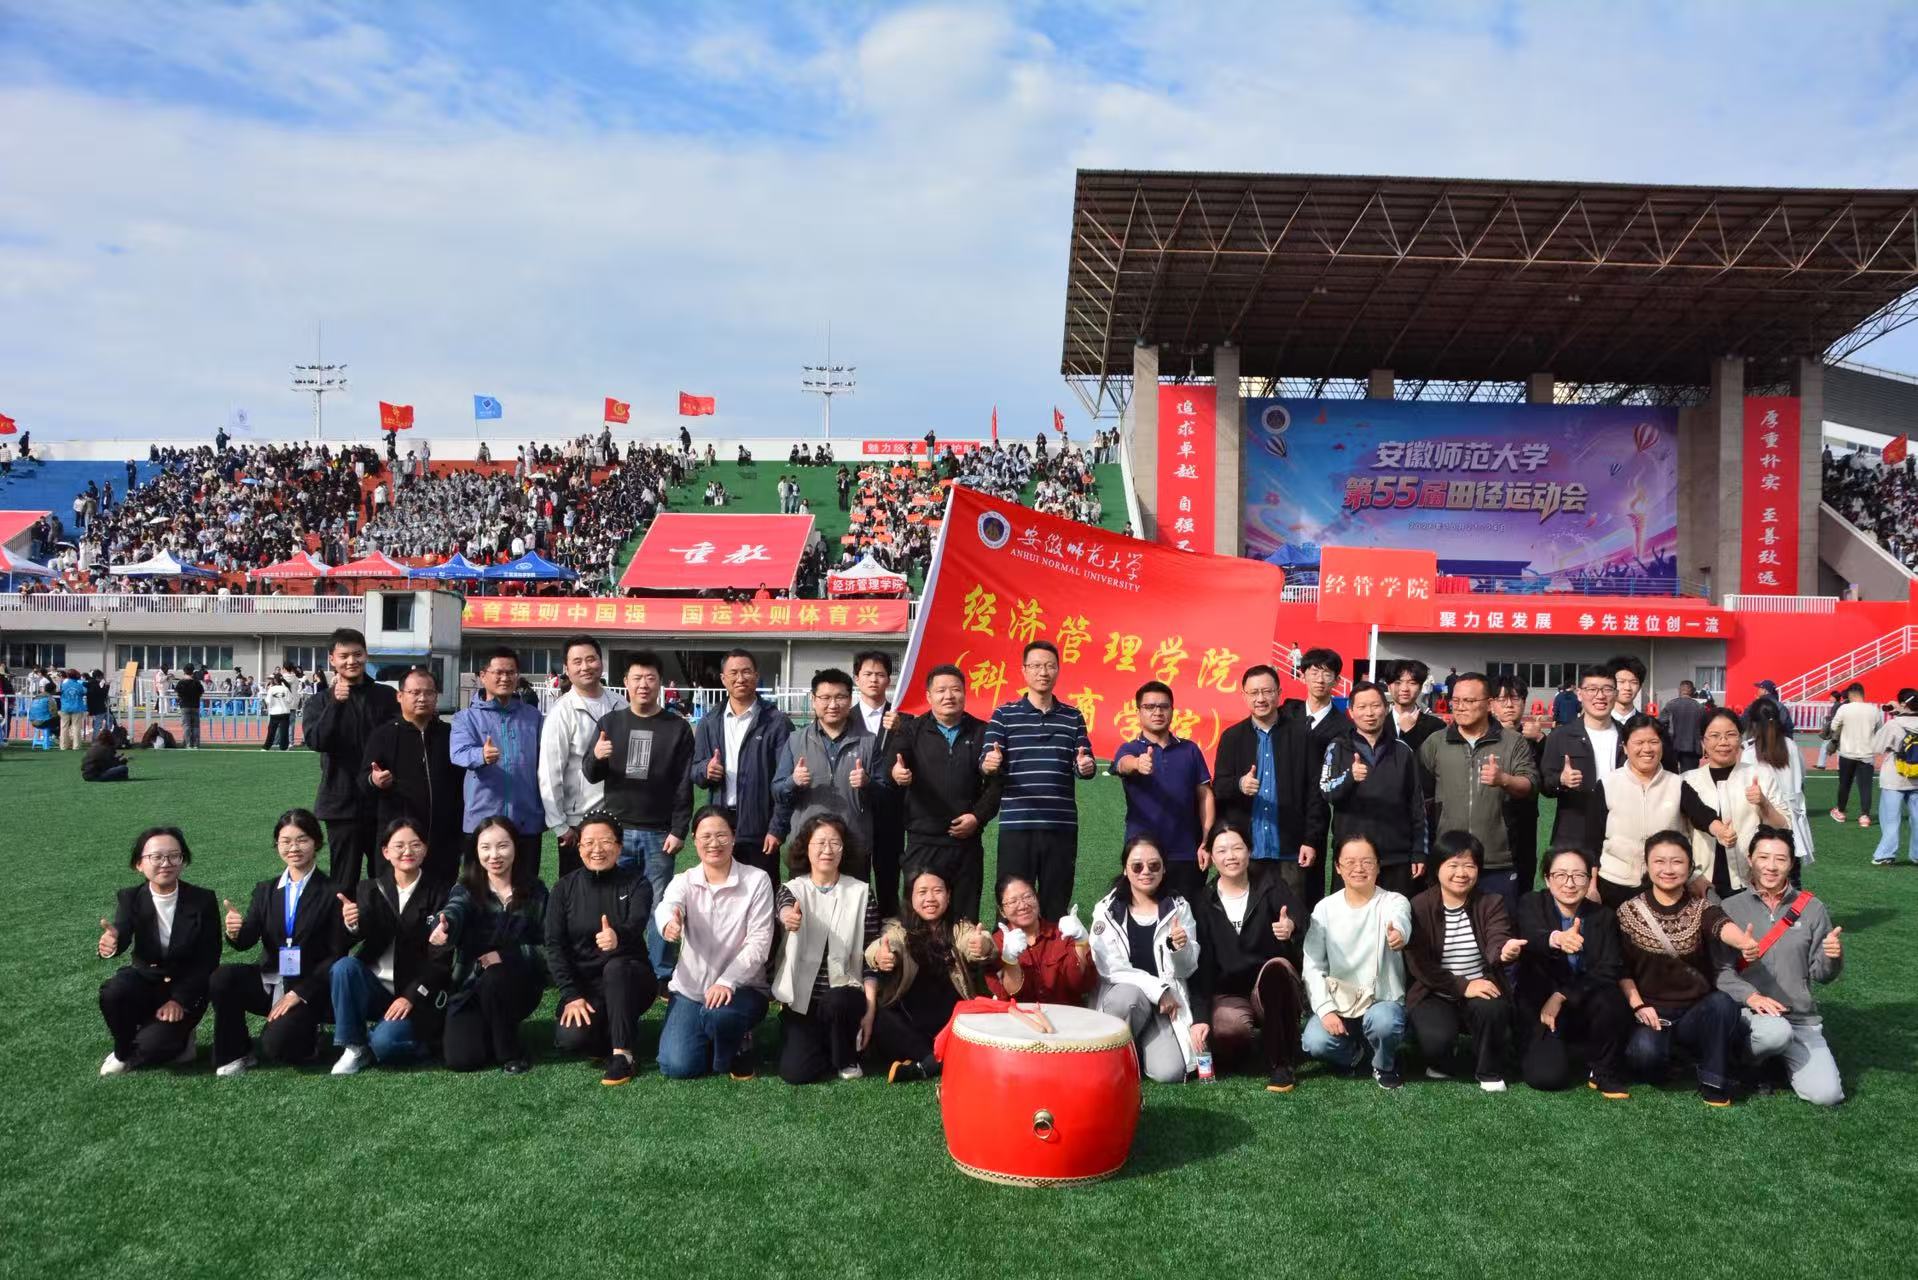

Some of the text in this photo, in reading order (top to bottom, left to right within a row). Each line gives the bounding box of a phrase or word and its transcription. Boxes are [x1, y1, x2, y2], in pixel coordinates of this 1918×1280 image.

[1173, 400, 1199, 479] 追求卓越
[1370, 440, 1550, 471] 安徽师范大学
[1343, 475, 1589, 523] 第55届田径运动会
[1757, 409, 1782, 586] 厚重朴实 至善致远
[1010, 548, 1141, 593] ANHUI NORMAL UNIVERSITY
[1017, 526, 1143, 580] 安徽师范大学
[832, 578, 904, 591] 经济管理学院
[1324, 572, 1430, 600] 经管学院
[462, 601, 880, 626] 体育强则中国强 国运兴则体育兴
[1439, 610, 1720, 633] 聚力促发展 争先进位创一流
[962, 583, 1240, 693] 经济管理学院
